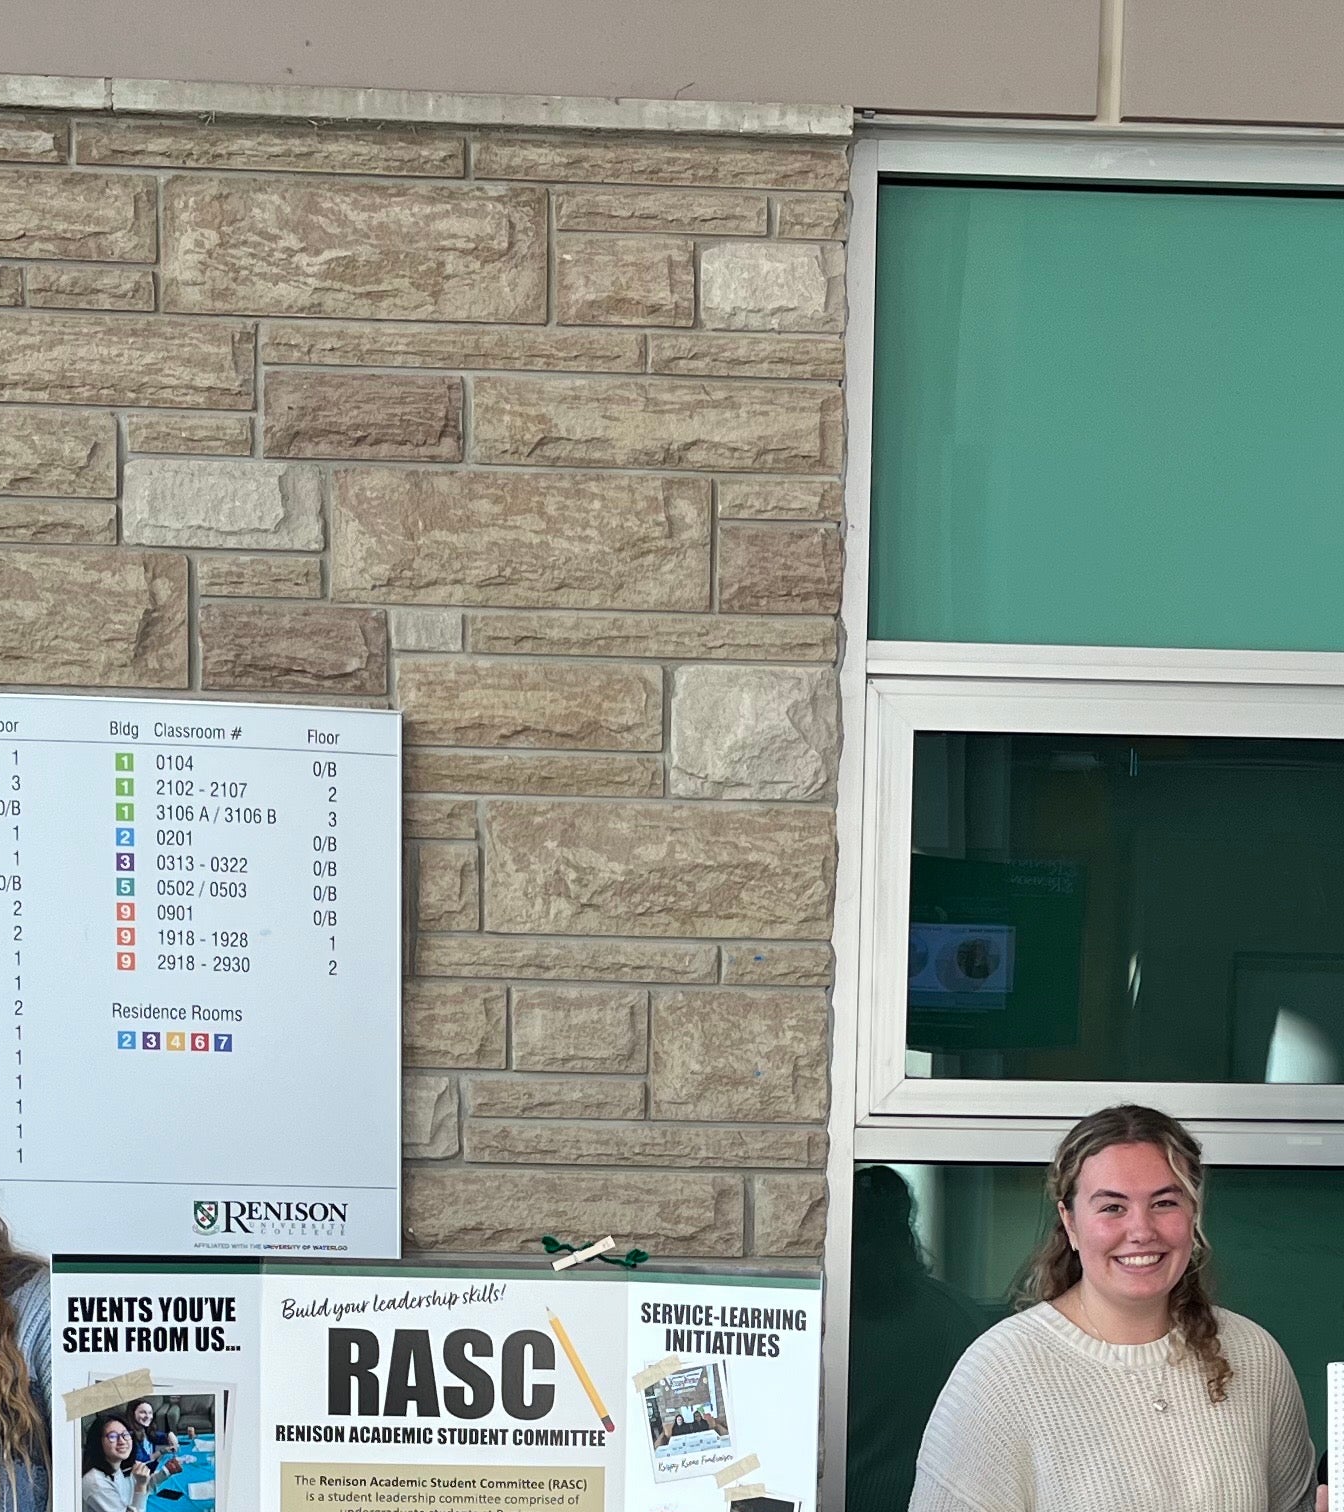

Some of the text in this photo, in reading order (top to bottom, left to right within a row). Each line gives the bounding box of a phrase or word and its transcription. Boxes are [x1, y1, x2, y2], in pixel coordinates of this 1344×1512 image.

[110, 721, 339, 744] Bldg Classroom # Floor
[157, 755, 193, 771] 0104
[313, 761, 336, 777] 0/B
[157, 780, 247, 798] 2102 2107
[157, 830, 191, 846] 0201
[158, 905, 192, 920] 0901
[158, 954, 250, 972] 2918 2930
[113, 1003, 242, 1021] Residence Rooms
[221, 1201, 348, 1234] RENISON
[250, 1222, 346, 1230] UNIVERSITY
[260, 1228, 345, 1236] COLLEGE
[68, 1297, 236, 1322] EVENTS YOU'VE
[282, 1284, 507, 1321] Build your leadership skills!
[641, 1302, 806, 1331] SERVICE-LEARNING
[63, 1327, 118, 1353] SEEN
[126, 1327, 188, 1352] FROM
[666, 1329, 780, 1357] INITIATIVES
[328, 1328, 555, 1420] RASC
[276, 1425, 605, 1447] RENISON ACADEMIC STUDENT COMMITTEE
[294, 1475, 587, 1492] The Renison Academic Student Committee (RASC)
[328, 1492, 580, 1507] student leadership committee comprised of
